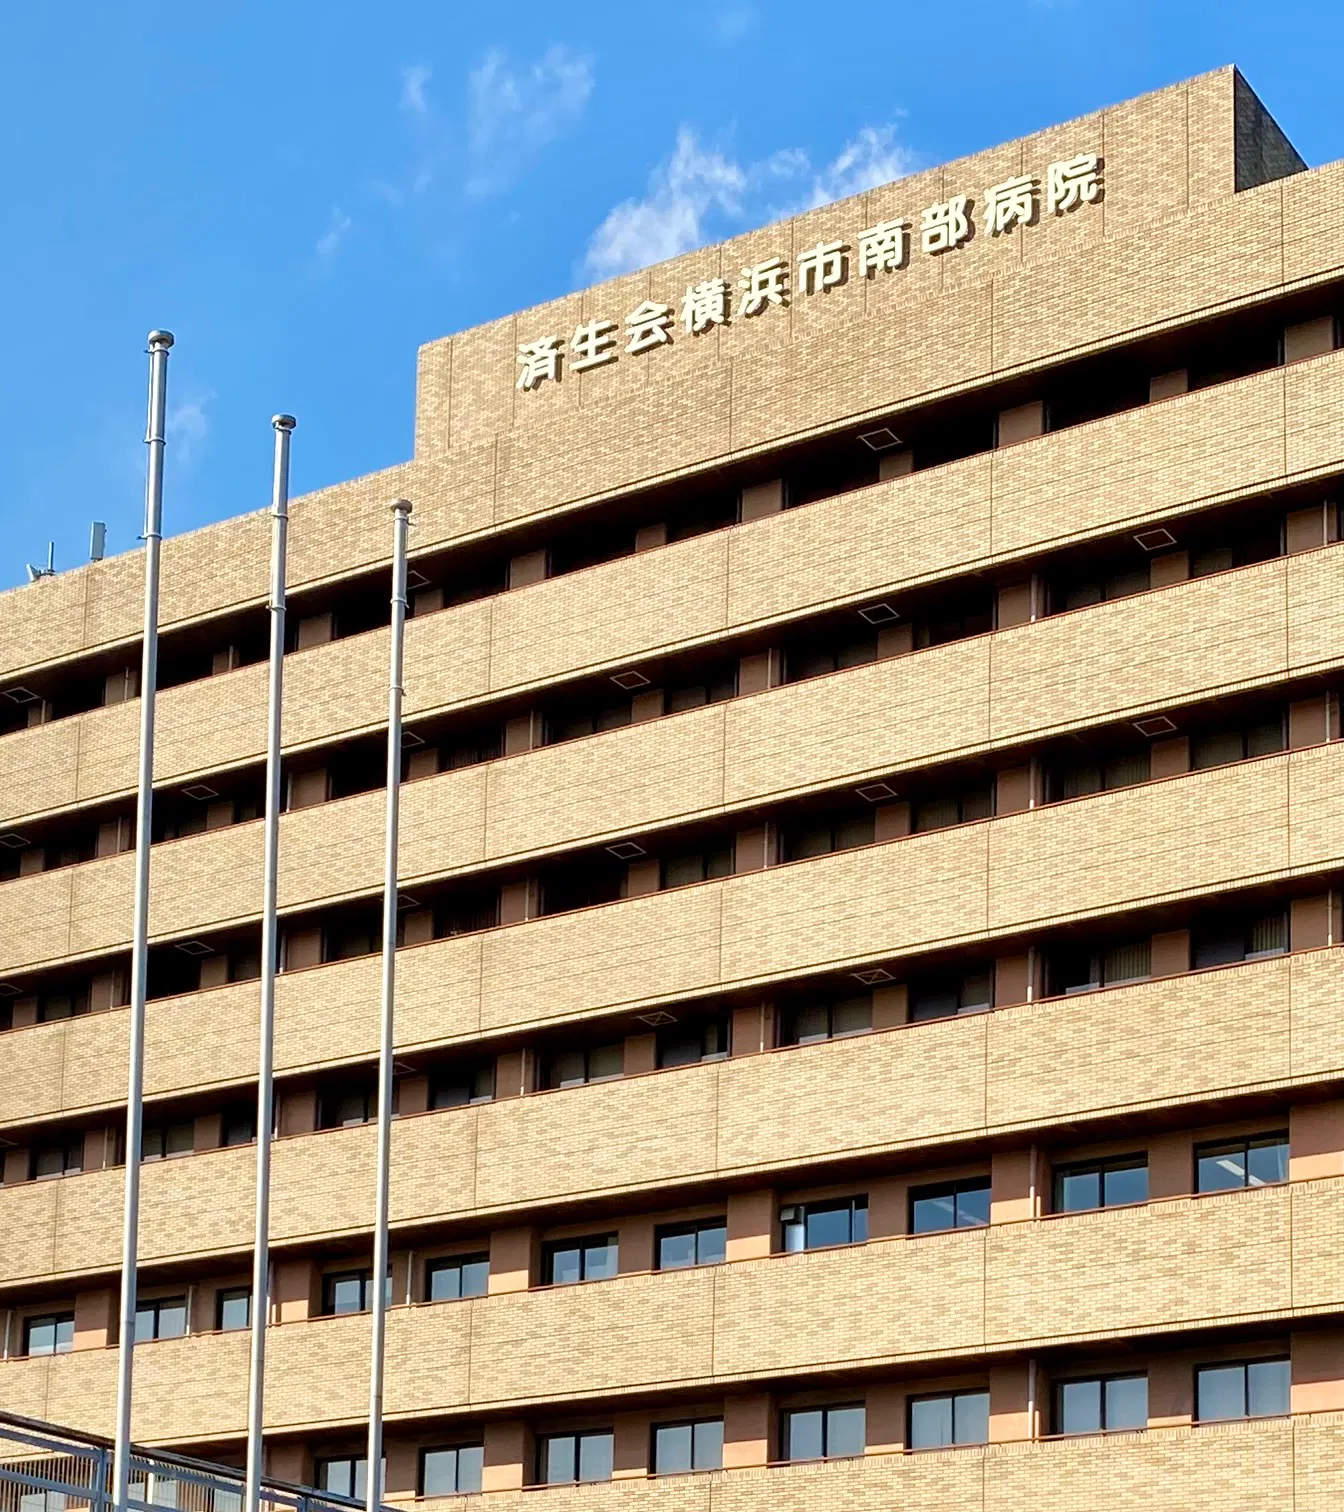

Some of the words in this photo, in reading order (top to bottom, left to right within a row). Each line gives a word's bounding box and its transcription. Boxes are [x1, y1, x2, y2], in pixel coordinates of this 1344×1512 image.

[514, 152, 1100, 390] 済生会横浜市南部病院
